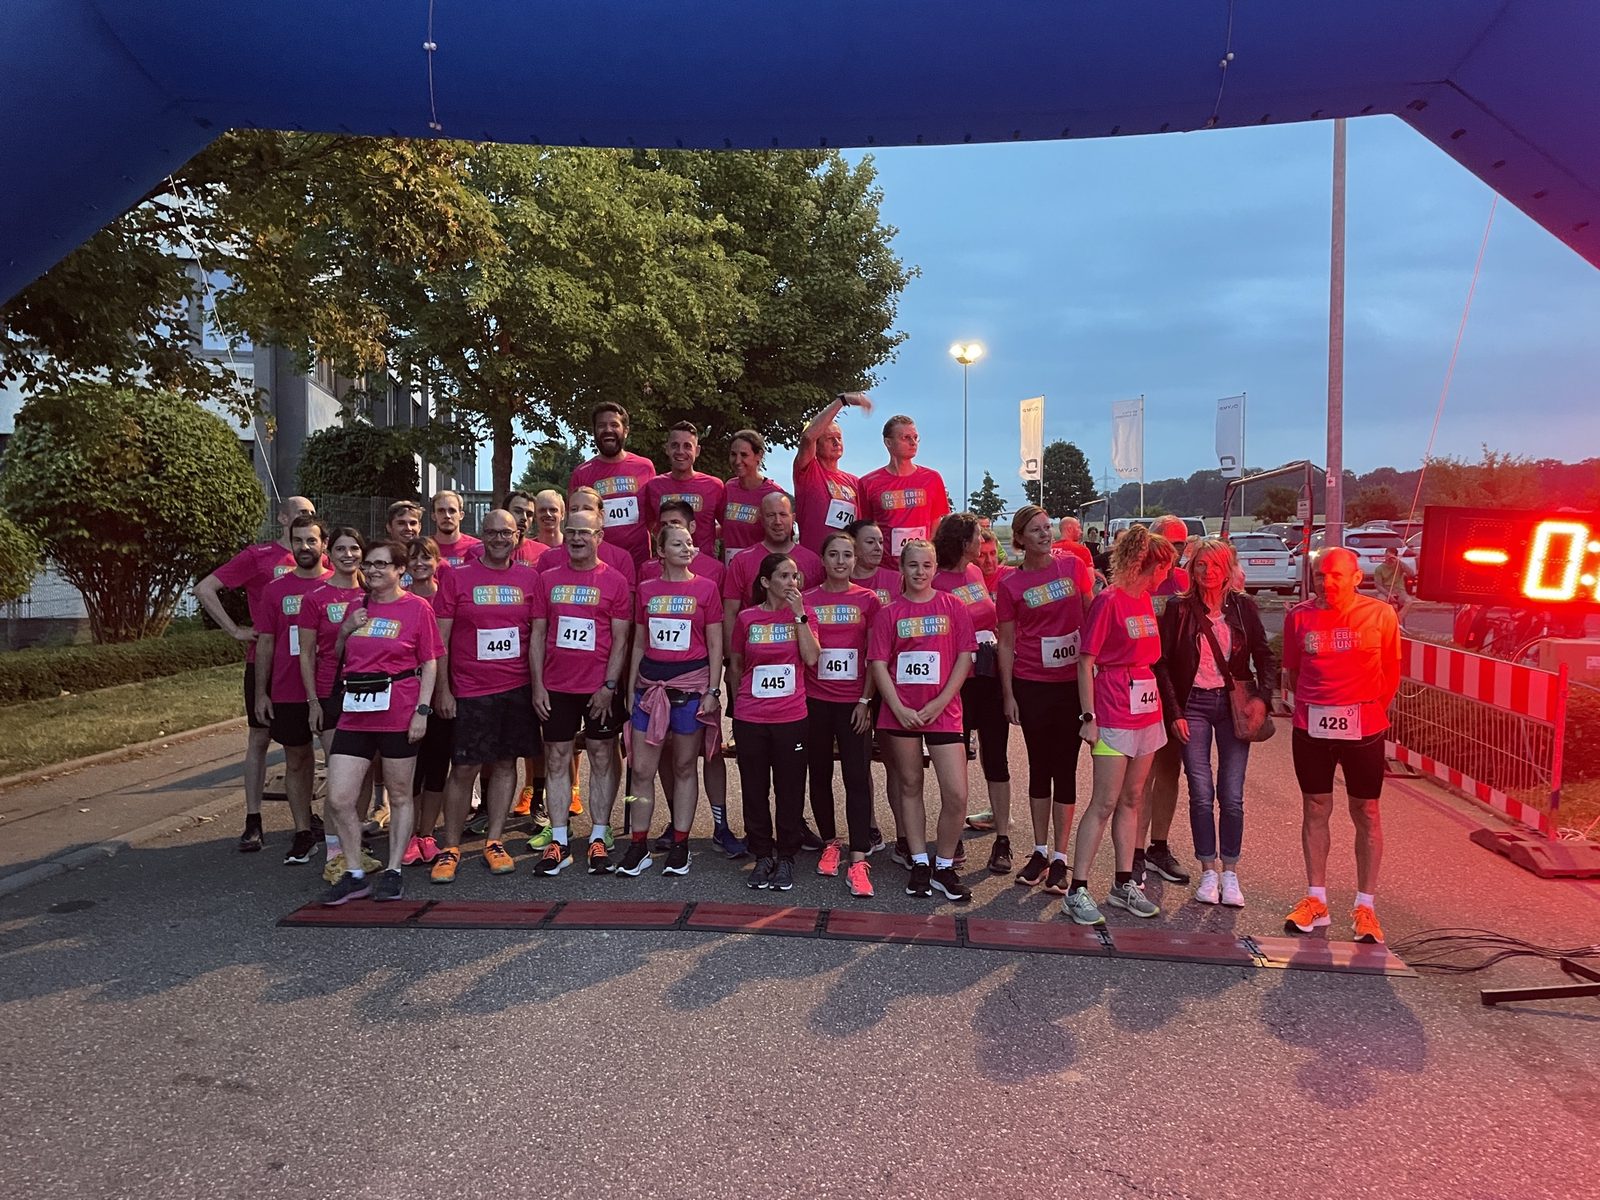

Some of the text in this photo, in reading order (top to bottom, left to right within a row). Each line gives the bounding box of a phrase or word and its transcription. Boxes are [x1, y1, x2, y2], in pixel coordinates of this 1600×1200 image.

[609, 507, 630, 519] 401
[836, 511, 854, 523] 470
[1027, 579, 1070, 598] DAS LEBEN
[1029, 595, 1045, 606] IST
[371, 620, 398, 629] LEBEN
[920, 617, 946, 625] LEBEN
[563, 628, 588, 642] 412
[656, 629, 680, 642] 417
[770, 625, 795, 633] LEBEN
[901, 626, 916, 635] IST
[487, 639, 511, 652] 449
[1052, 644, 1076, 660] 400
[826, 659, 848, 672] 461
[905, 663, 929, 676] 463
[761, 676, 785, 689] 445
[1318, 716, 1348, 730] 428
